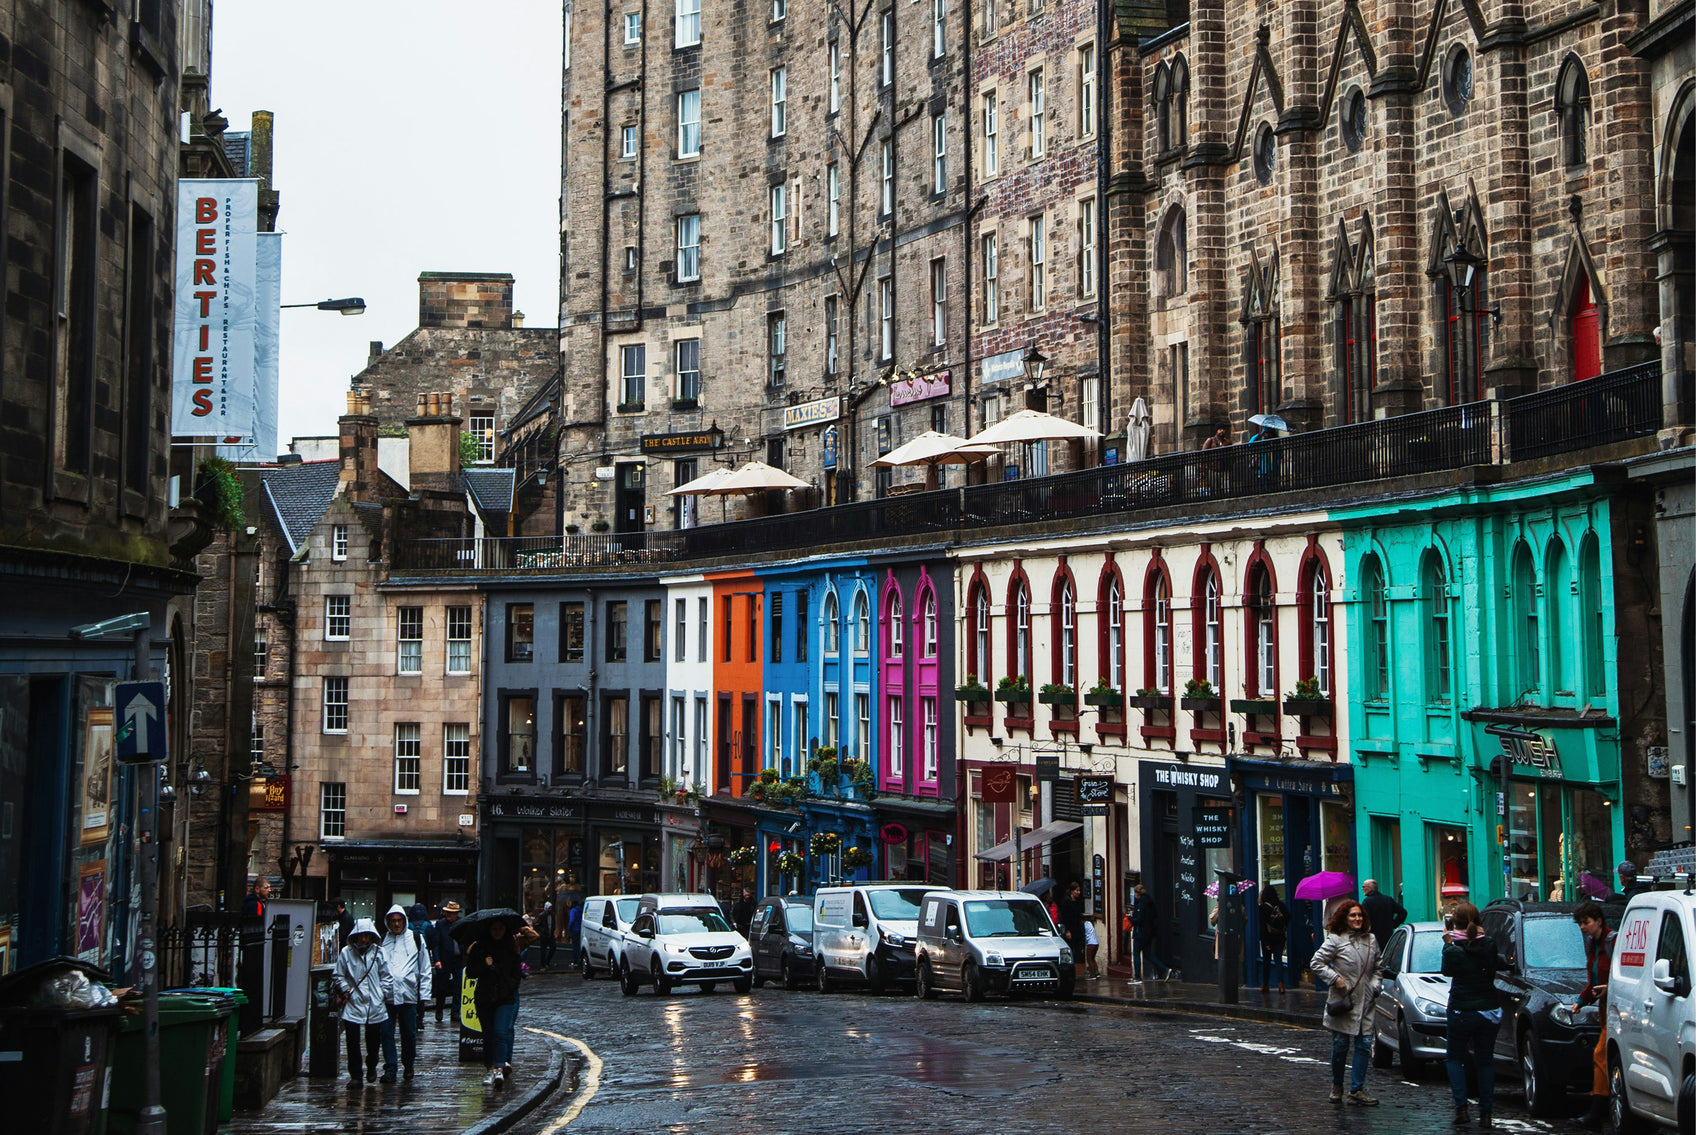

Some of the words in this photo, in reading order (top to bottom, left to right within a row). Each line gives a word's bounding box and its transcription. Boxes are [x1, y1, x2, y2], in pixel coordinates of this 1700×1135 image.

[224, 198, 232, 237] PROPER
[223, 239, 231, 266] FISH
[222, 276, 230, 309] CHIPS
[191, 197, 219, 417] BERTIES
[220, 319, 229, 386] RESTAURANT
[219, 396, 227, 416] BAR
[644, 438, 660, 448] THE
[661, 437, 693, 447] CASTLE
[1155, 769, 1169, 783] THE
[1170, 766, 1199, 787] WHISKY
[1200, 773, 1219, 788] SHOP
[265, 794, 285, 802] izard
